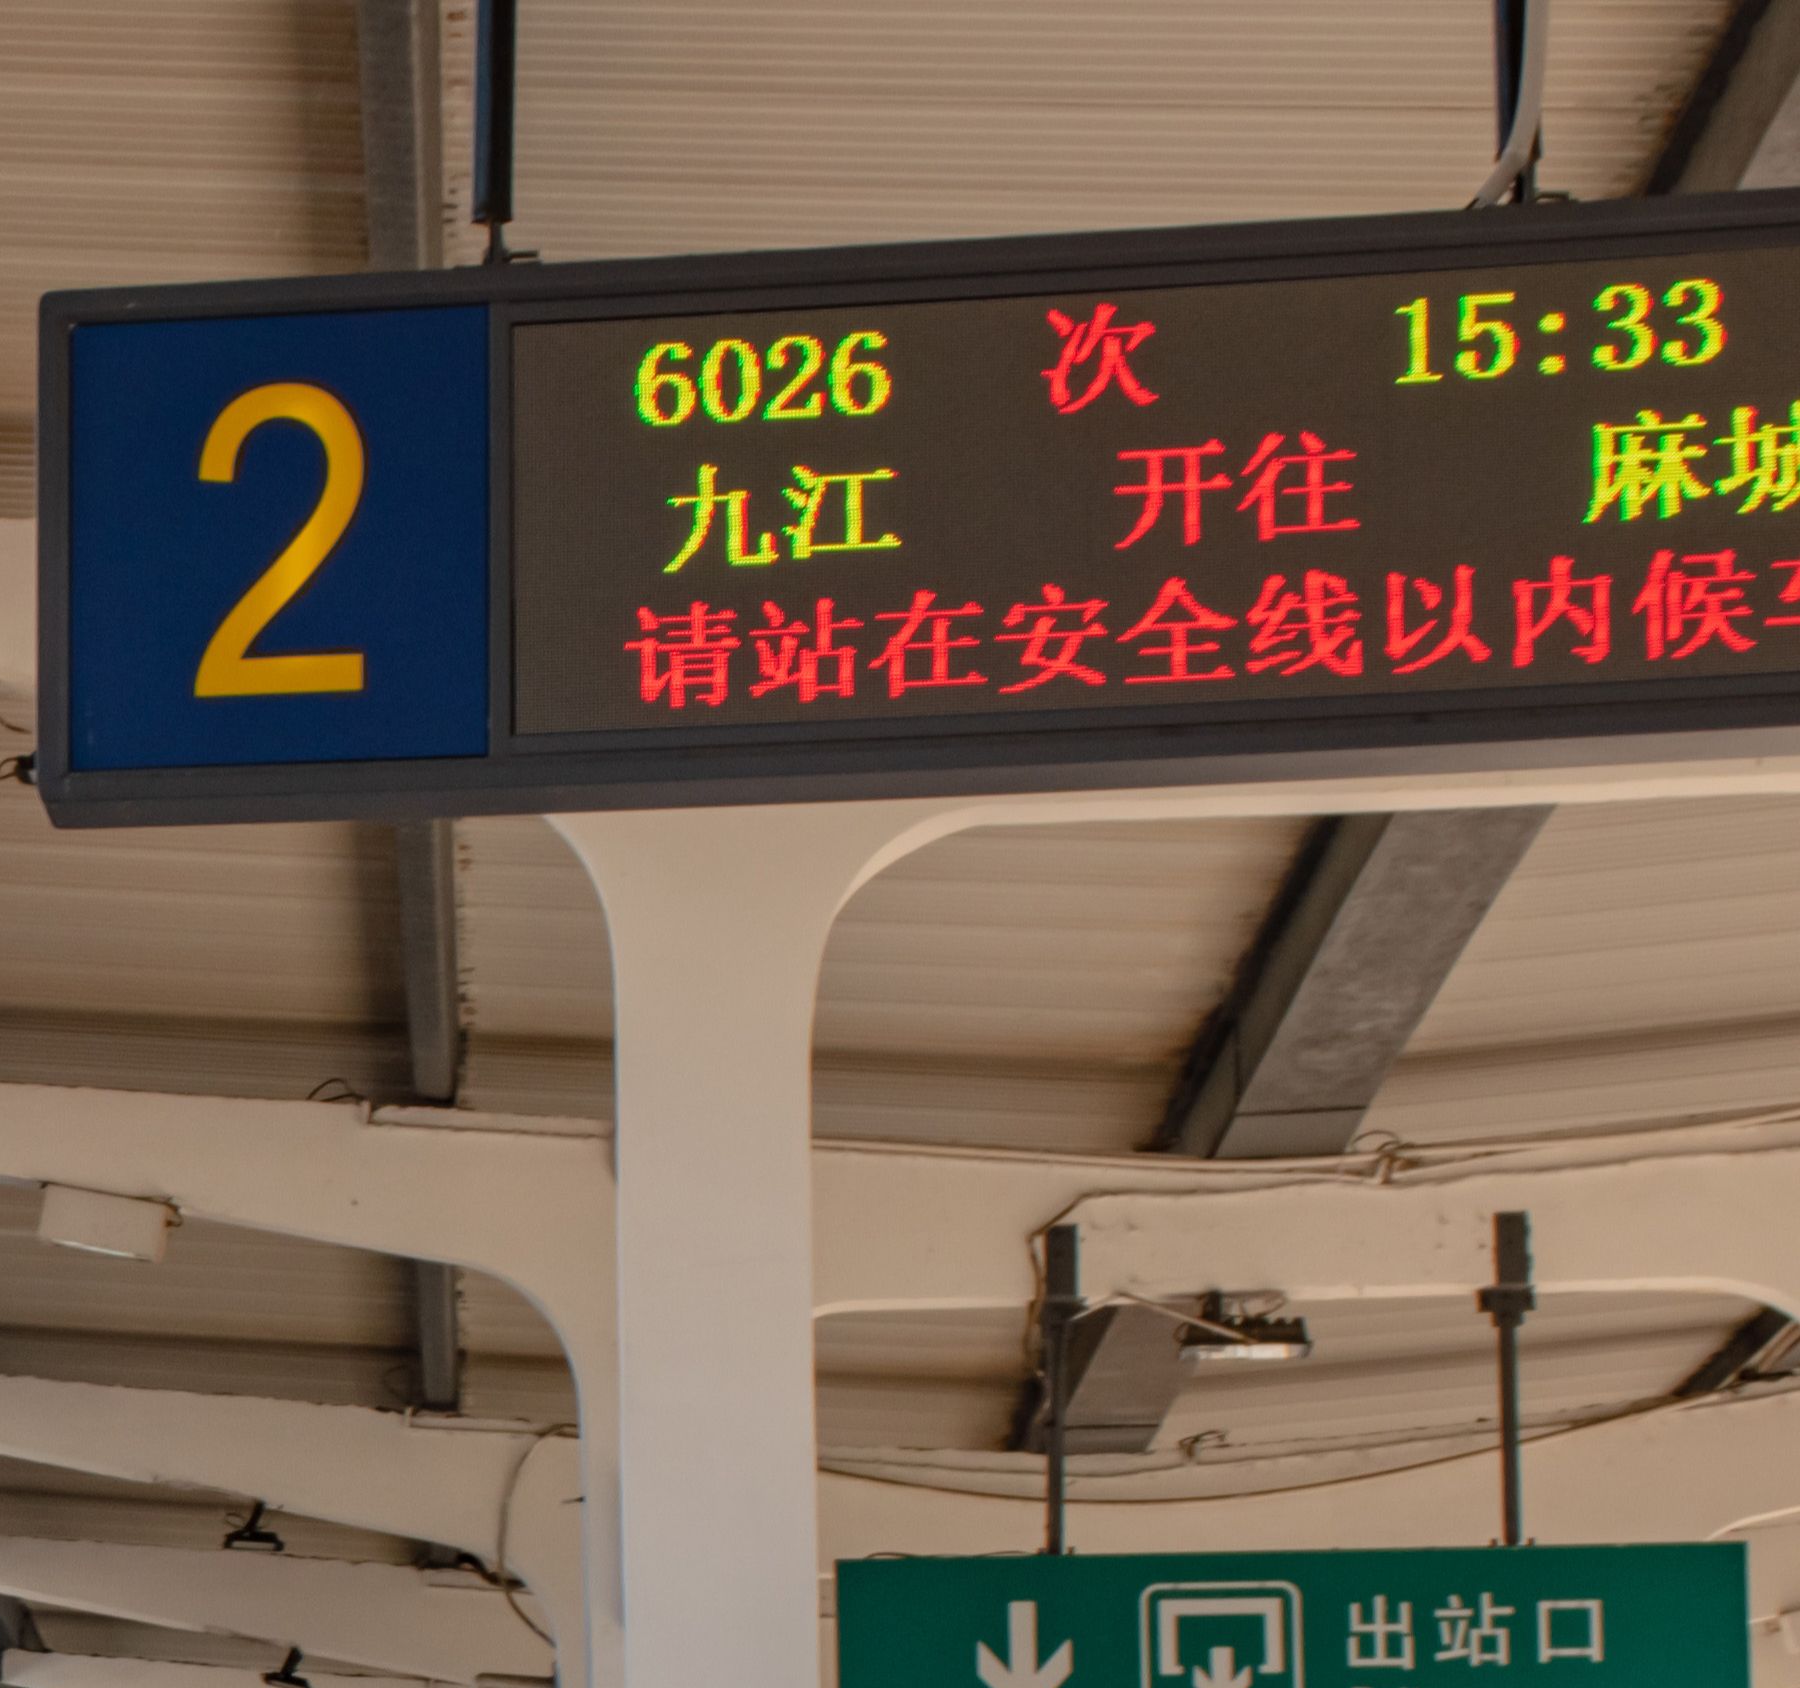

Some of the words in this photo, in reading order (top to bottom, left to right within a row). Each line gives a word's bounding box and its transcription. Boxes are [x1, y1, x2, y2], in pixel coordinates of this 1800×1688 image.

[634, 330, 892, 427] 6026
[1041, 304, 1159, 415] 次
[1394, 278, 1729, 385] 15:33
[193, 380, 368, 699] 2
[663, 463, 902, 573] 九江
[1113, 431, 1361, 550] 开往
[1346, 1592, 1605, 1671] 出站口
